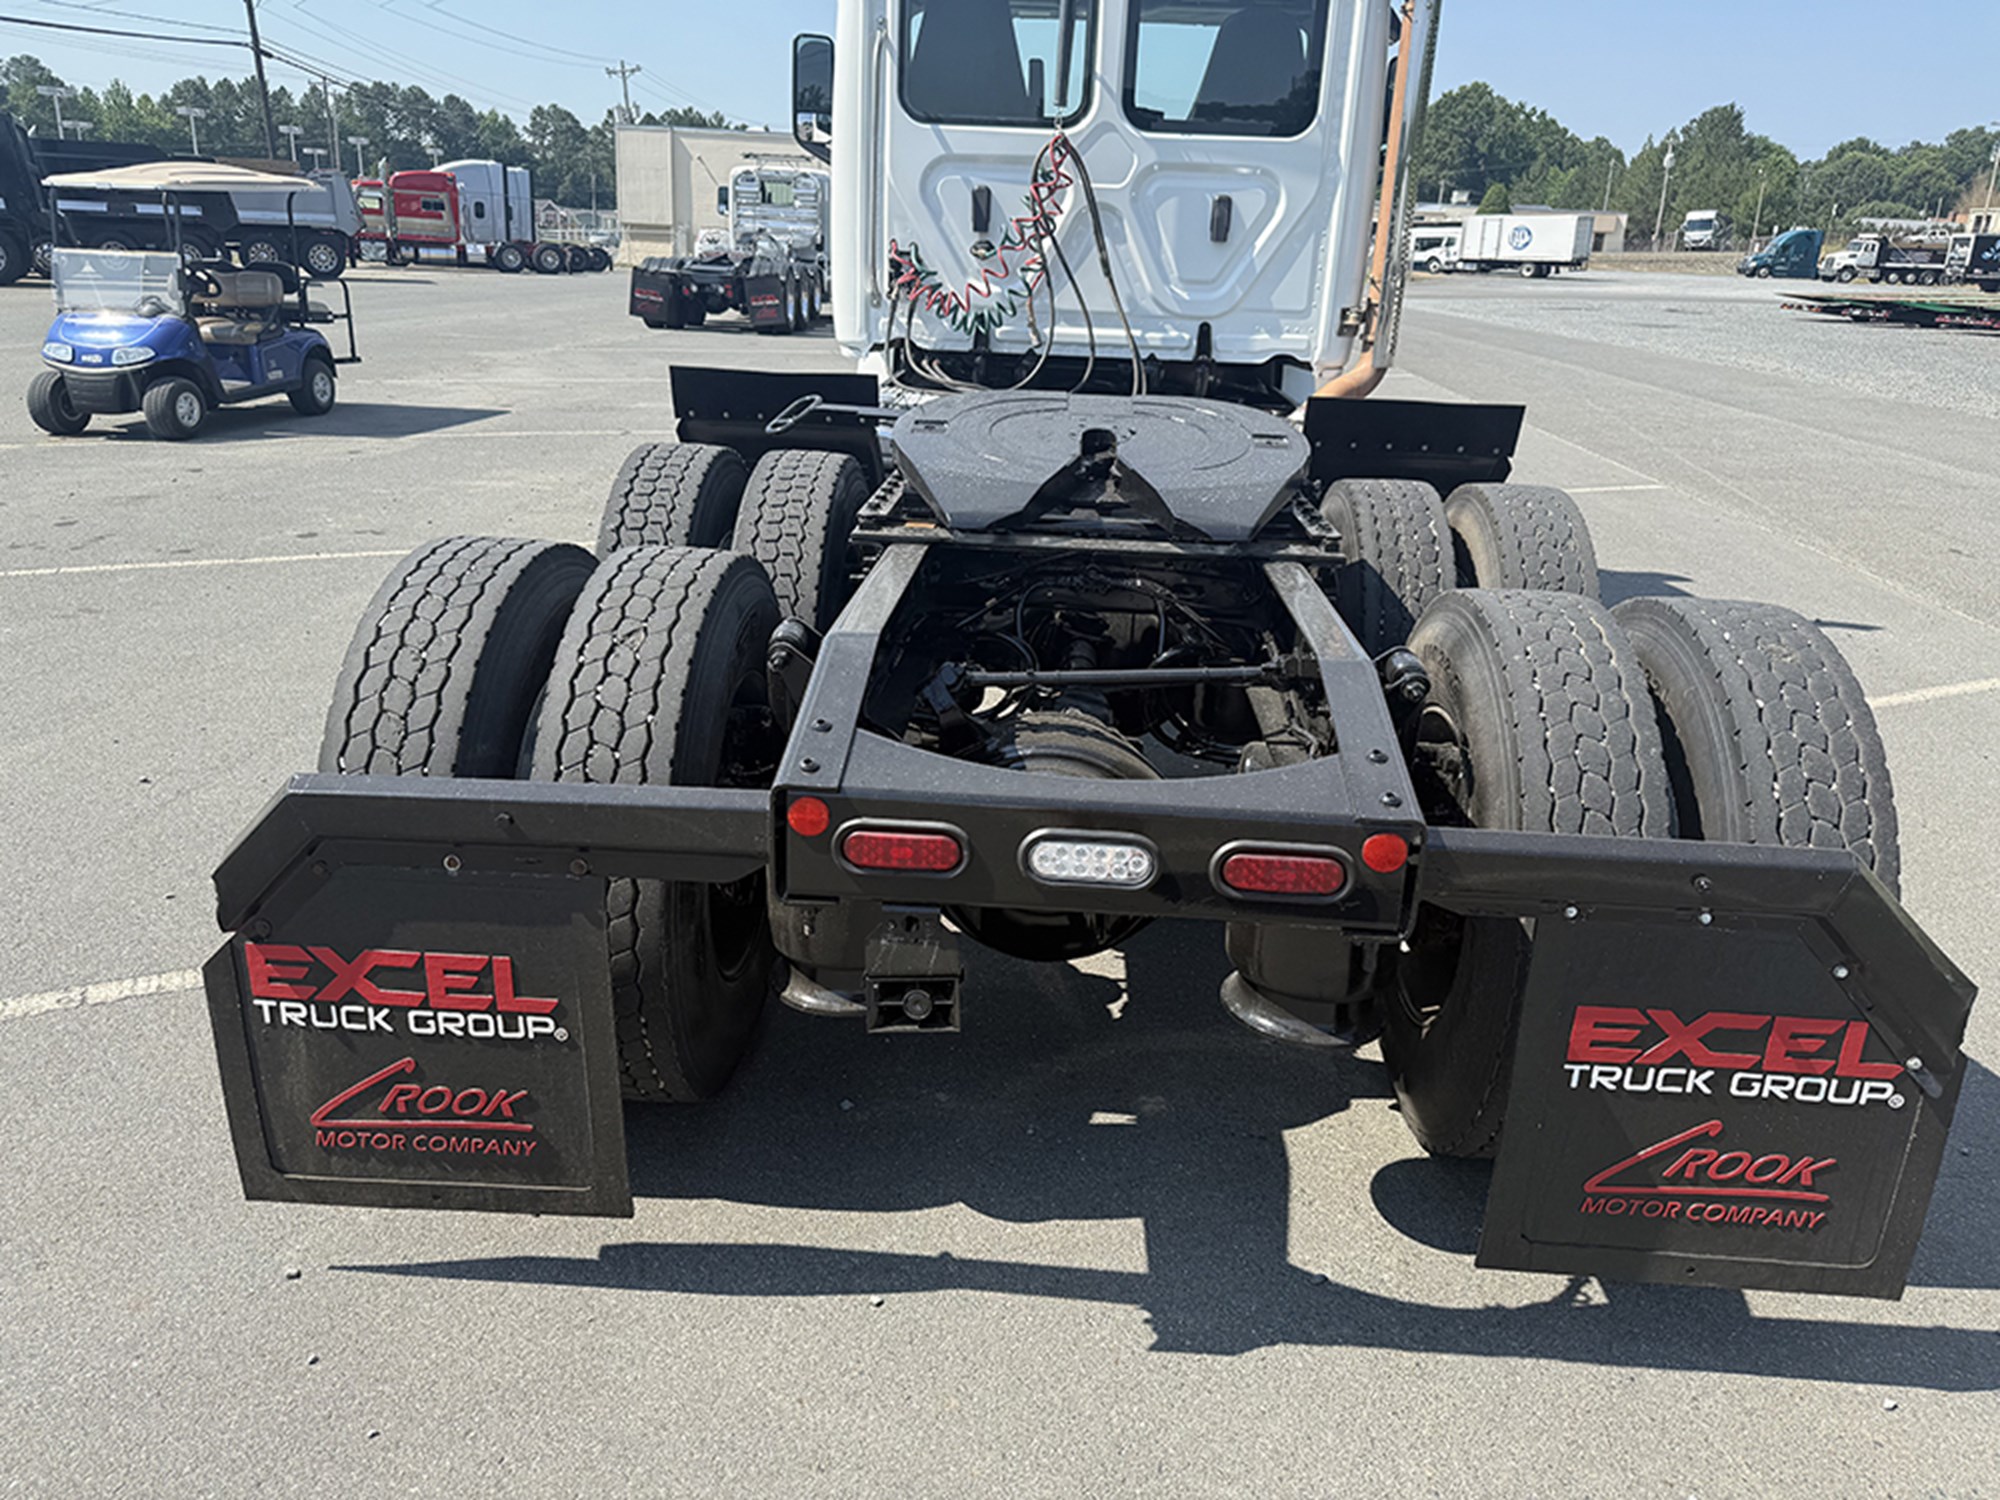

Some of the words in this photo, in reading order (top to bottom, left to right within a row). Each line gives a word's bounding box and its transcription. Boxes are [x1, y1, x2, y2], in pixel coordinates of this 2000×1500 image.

[245, 943, 559, 1014] EXCEL
[252, 998, 394, 1033] TRUCK
[1566, 1005, 1905, 1080] EXCEL
[1563, 1063, 1715, 1096] TRUCK
[315, 1130, 406, 1151] MOTOR
[412, 1135, 537, 1156] COMPANY
[1580, 1197, 1681, 1219] MOTOR
[1685, 1202, 1826, 1230] COMPANY
